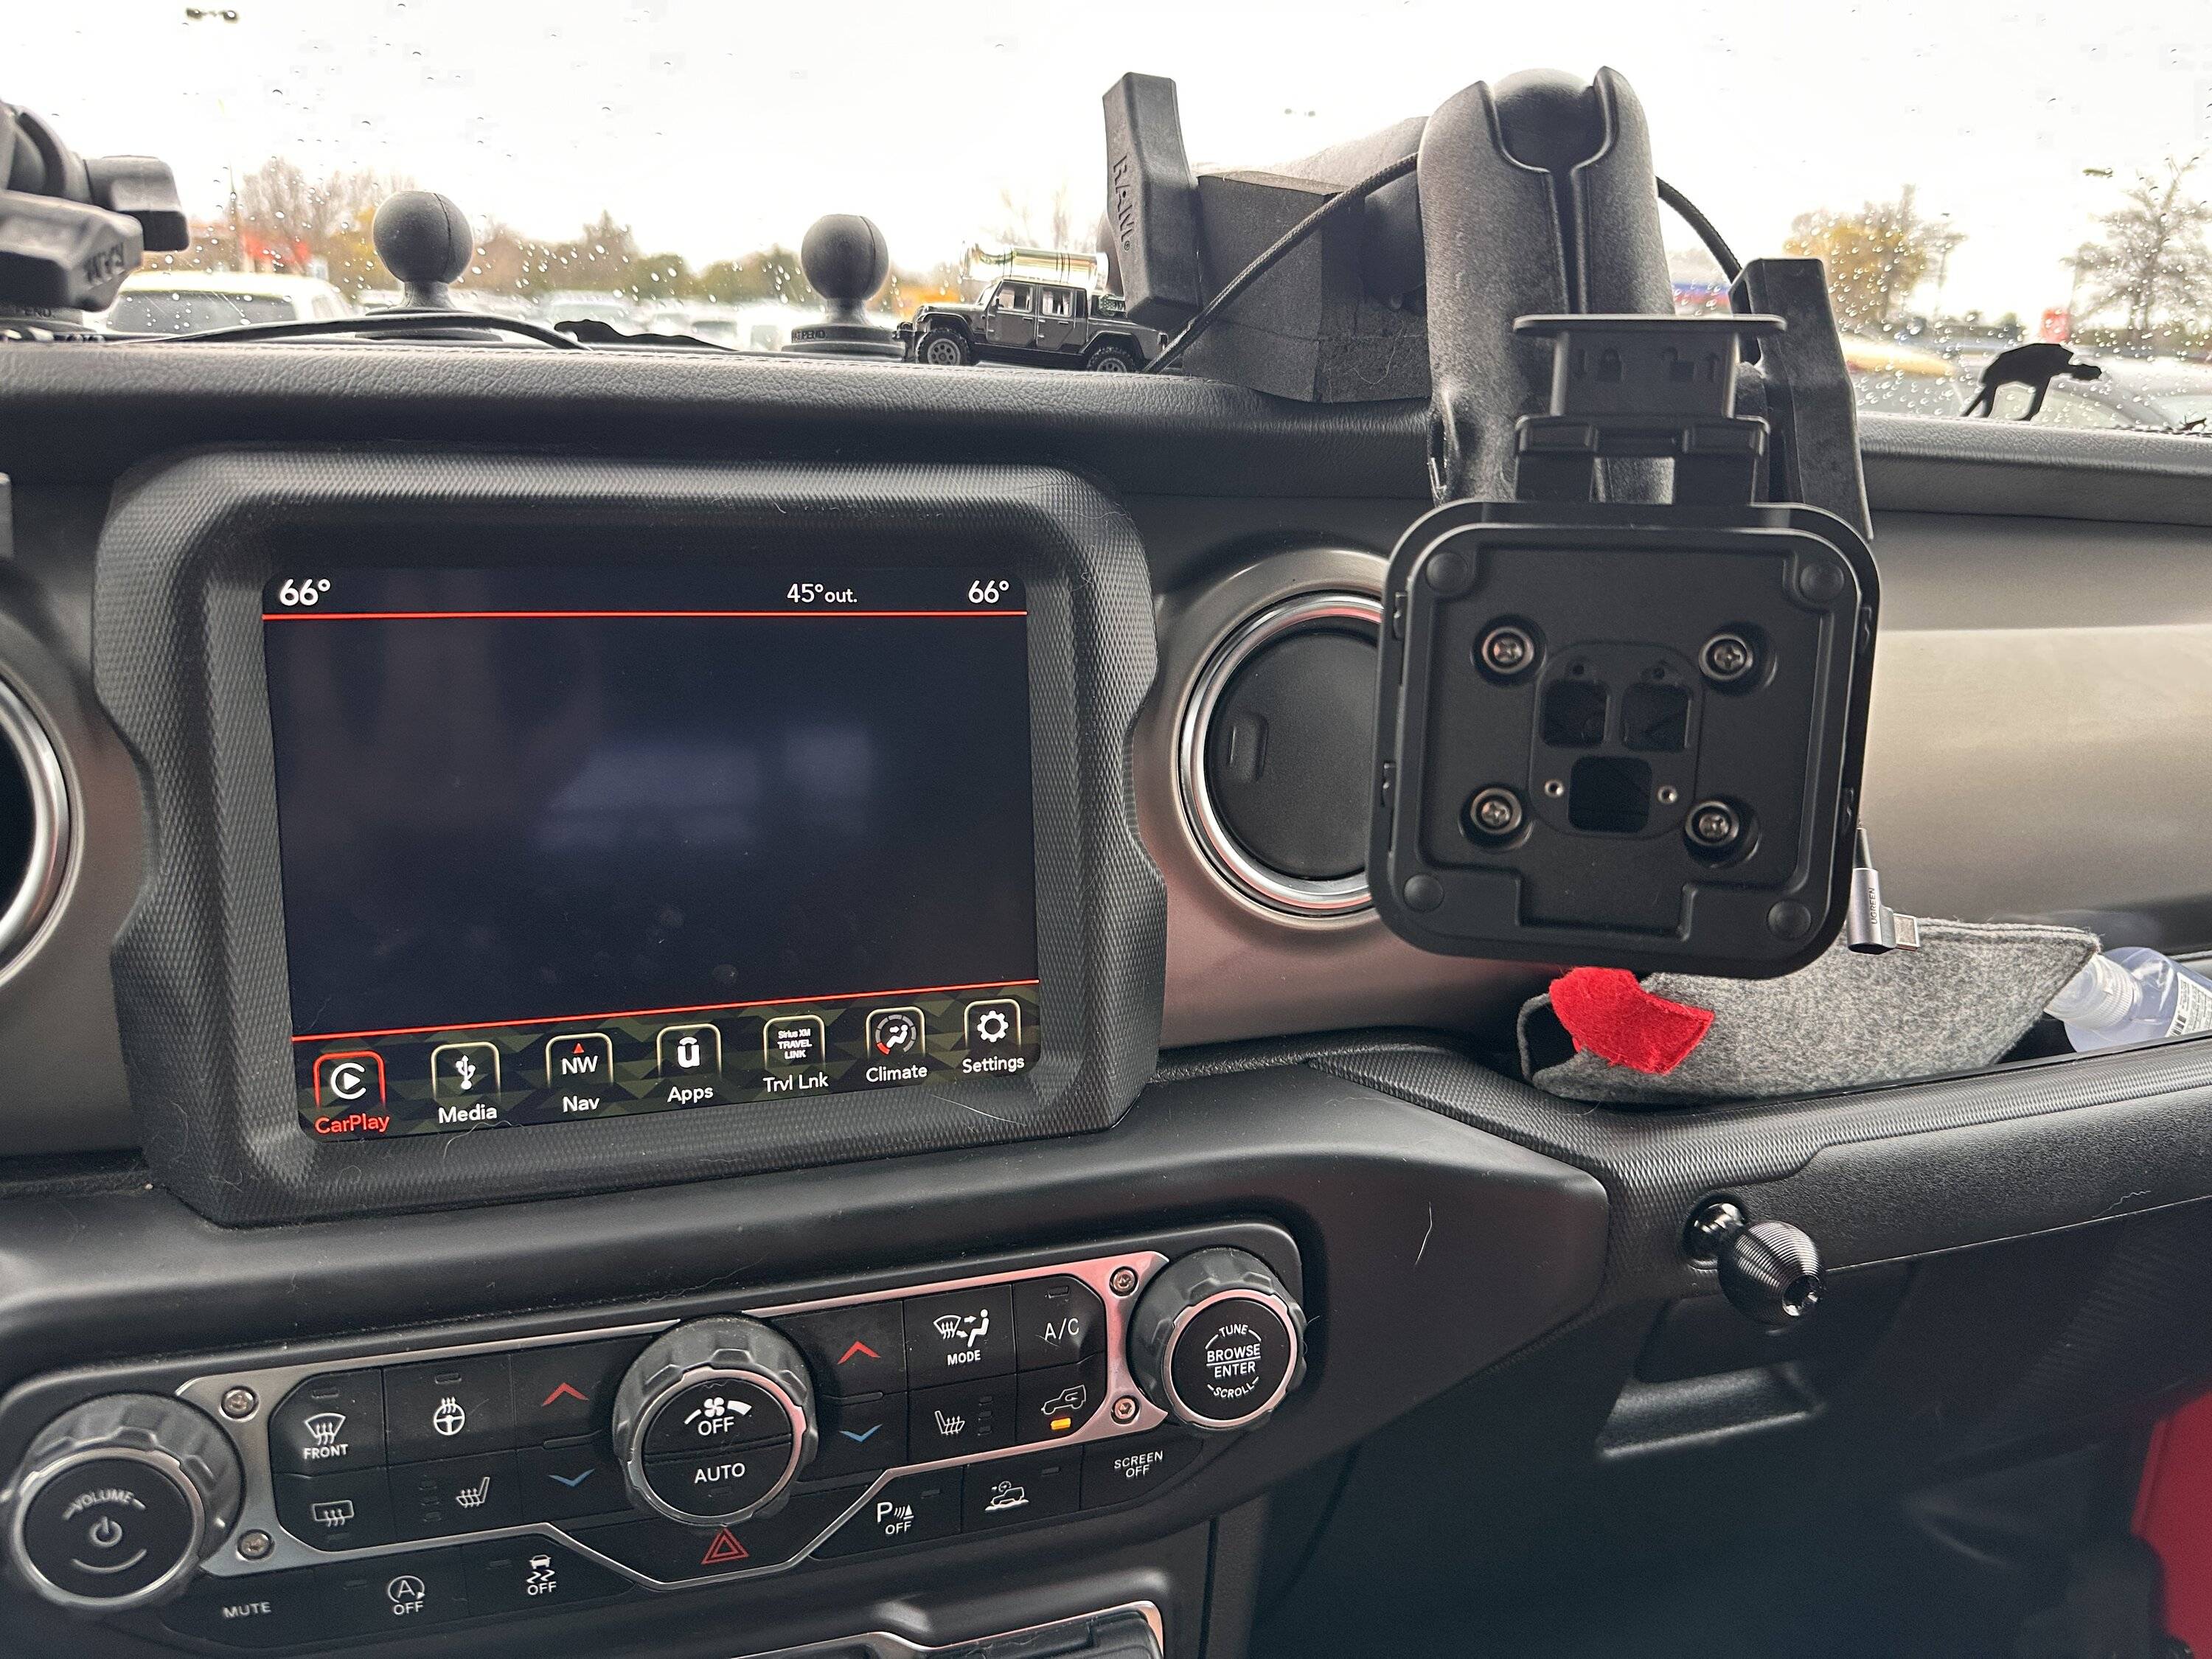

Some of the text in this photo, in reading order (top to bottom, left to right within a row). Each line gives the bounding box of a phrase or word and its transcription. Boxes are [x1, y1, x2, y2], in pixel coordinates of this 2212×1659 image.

[1868, 887, 1877, 925] UGREEN
[799, 1028, 811, 1037] XM
[777, 1039, 813, 1049] TRAVEL
[784, 1049, 807, 1060] LINK
[561, 1055, 599, 1075] NW
[866, 1064, 928, 1082] Climate
[962, 1057, 1025, 1075] Settings
[762, 1071, 830, 1093] Trvl Lnk
[667, 1085, 714, 1105] Apps
[563, 1096, 600, 1112] Nav
[438, 1105, 498, 1124] Media
[314, 1113, 391, 1134] CarPlay
[1044, 1318, 1079, 1340] A/C
[1219, 1324, 1248, 1338] TUNE
[947, 1349, 981, 1366] MODE
[1207, 1343, 1261, 1363] BROWSE
[1214, 1361, 1256, 1378] ENTER
[1213, 1382, 1255, 1398] SCROLL
[698, 1416, 734, 1436] OFF
[303, 1444, 349, 1460] FRONT
[1114, 1450, 1164, 1470] SCREEN
[695, 1463, 745, 1484] AUTO
[1125, 1464, 1150, 1478] OFF
[74, 1489, 134, 1510] VOLUME
[886, 1521, 911, 1534] OFF
[527, 1582, 557, 1596] OFF
[223, 1602, 271, 1618] MUTE
[392, 1601, 424, 1615] OFF
